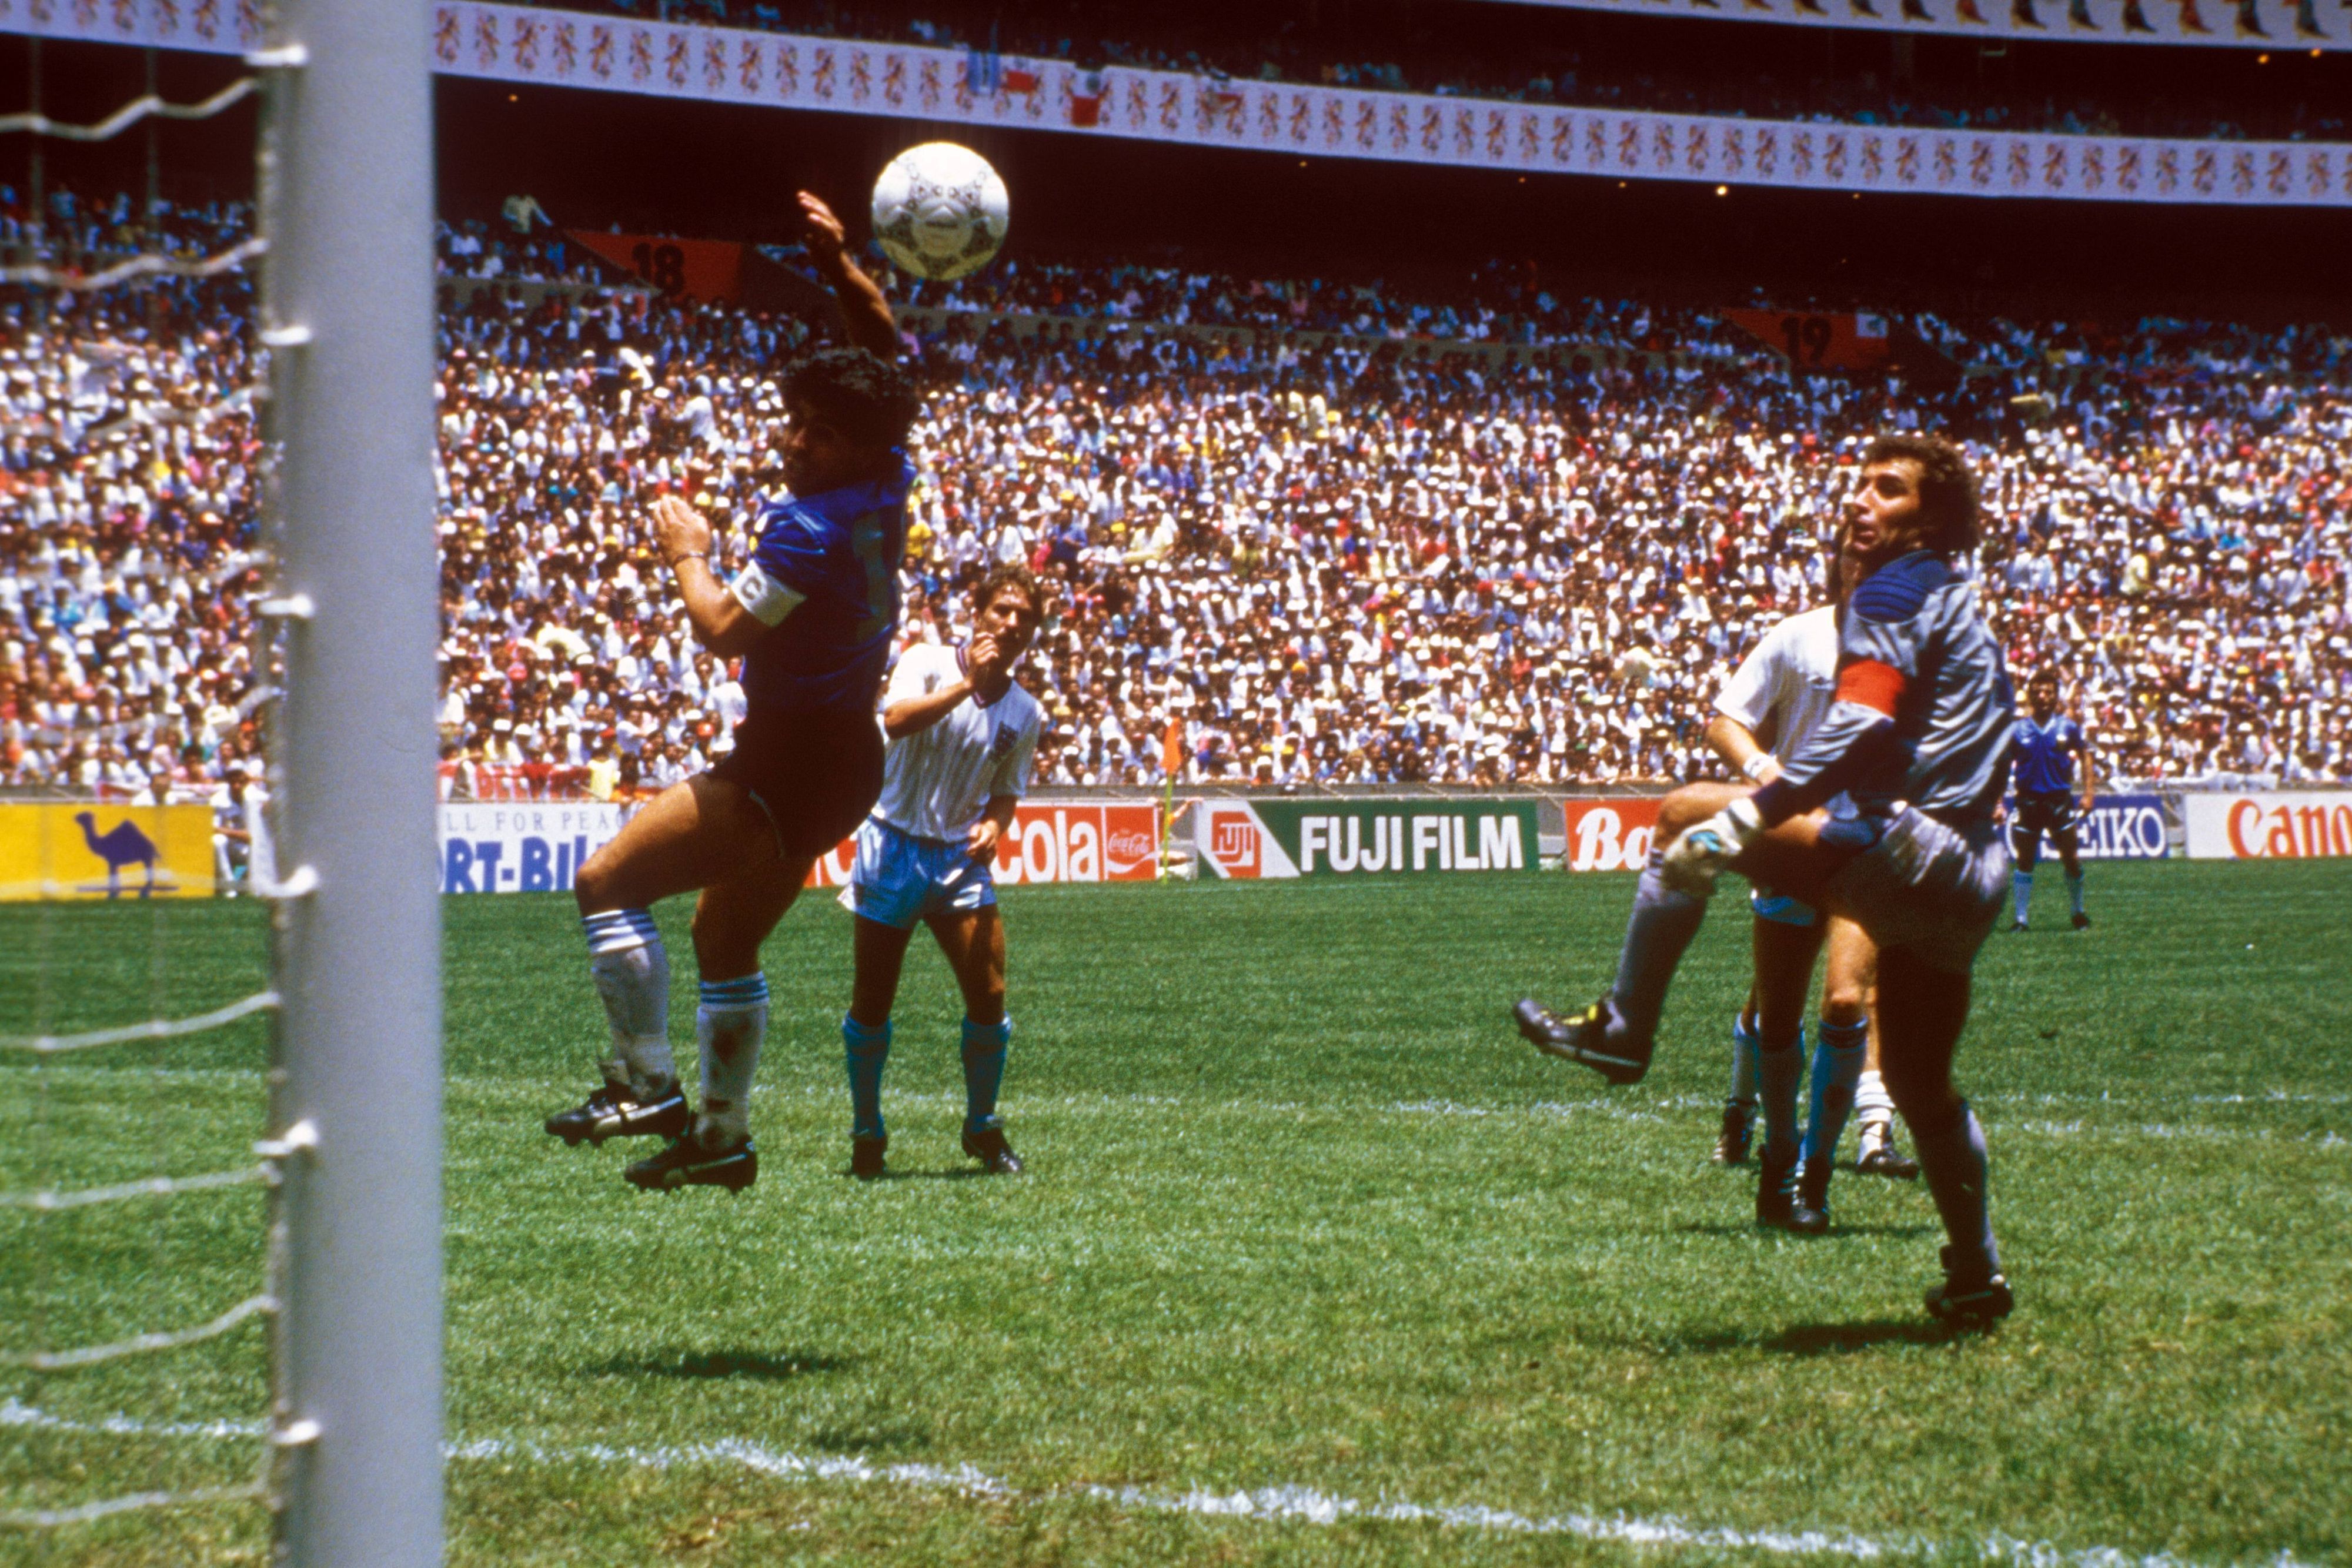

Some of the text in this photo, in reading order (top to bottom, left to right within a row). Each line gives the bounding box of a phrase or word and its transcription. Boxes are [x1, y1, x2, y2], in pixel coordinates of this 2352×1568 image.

[632, 242, 684, 293] 18
[1780, 317, 1830, 362] 19
[495, 811, 544, 831] FOR
[1301, 815, 1524, 871] FUJI FILM
